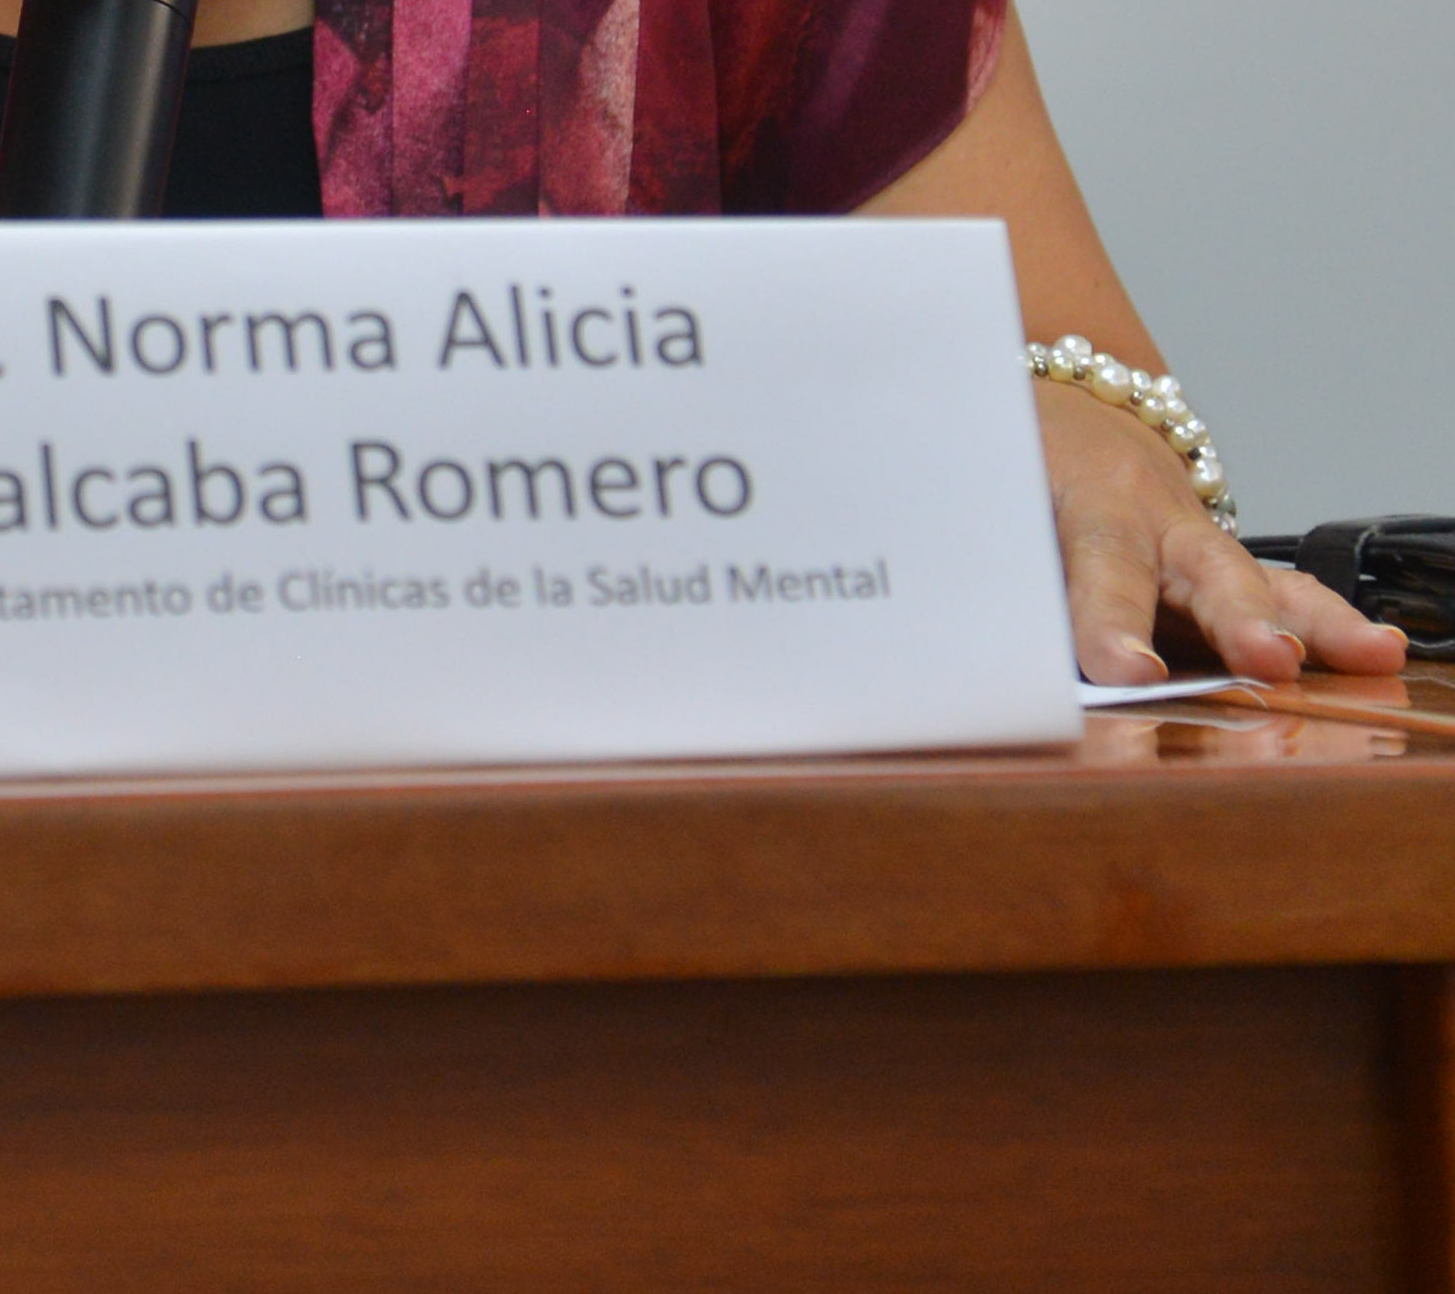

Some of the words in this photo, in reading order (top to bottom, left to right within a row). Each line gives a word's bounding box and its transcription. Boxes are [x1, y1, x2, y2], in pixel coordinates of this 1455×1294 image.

[45, 294, 397, 377] Norma
[437, 282, 704, 370] Alicia
[348, 438, 754, 523] Romero
[205, 572, 264, 613] de
[276, 569, 451, 612] Clínicas
[462, 567, 521, 608] de
[532, 566, 574, 607] la
[586, 564, 712, 606] Salud
[724, 557, 890, 602] Mental
